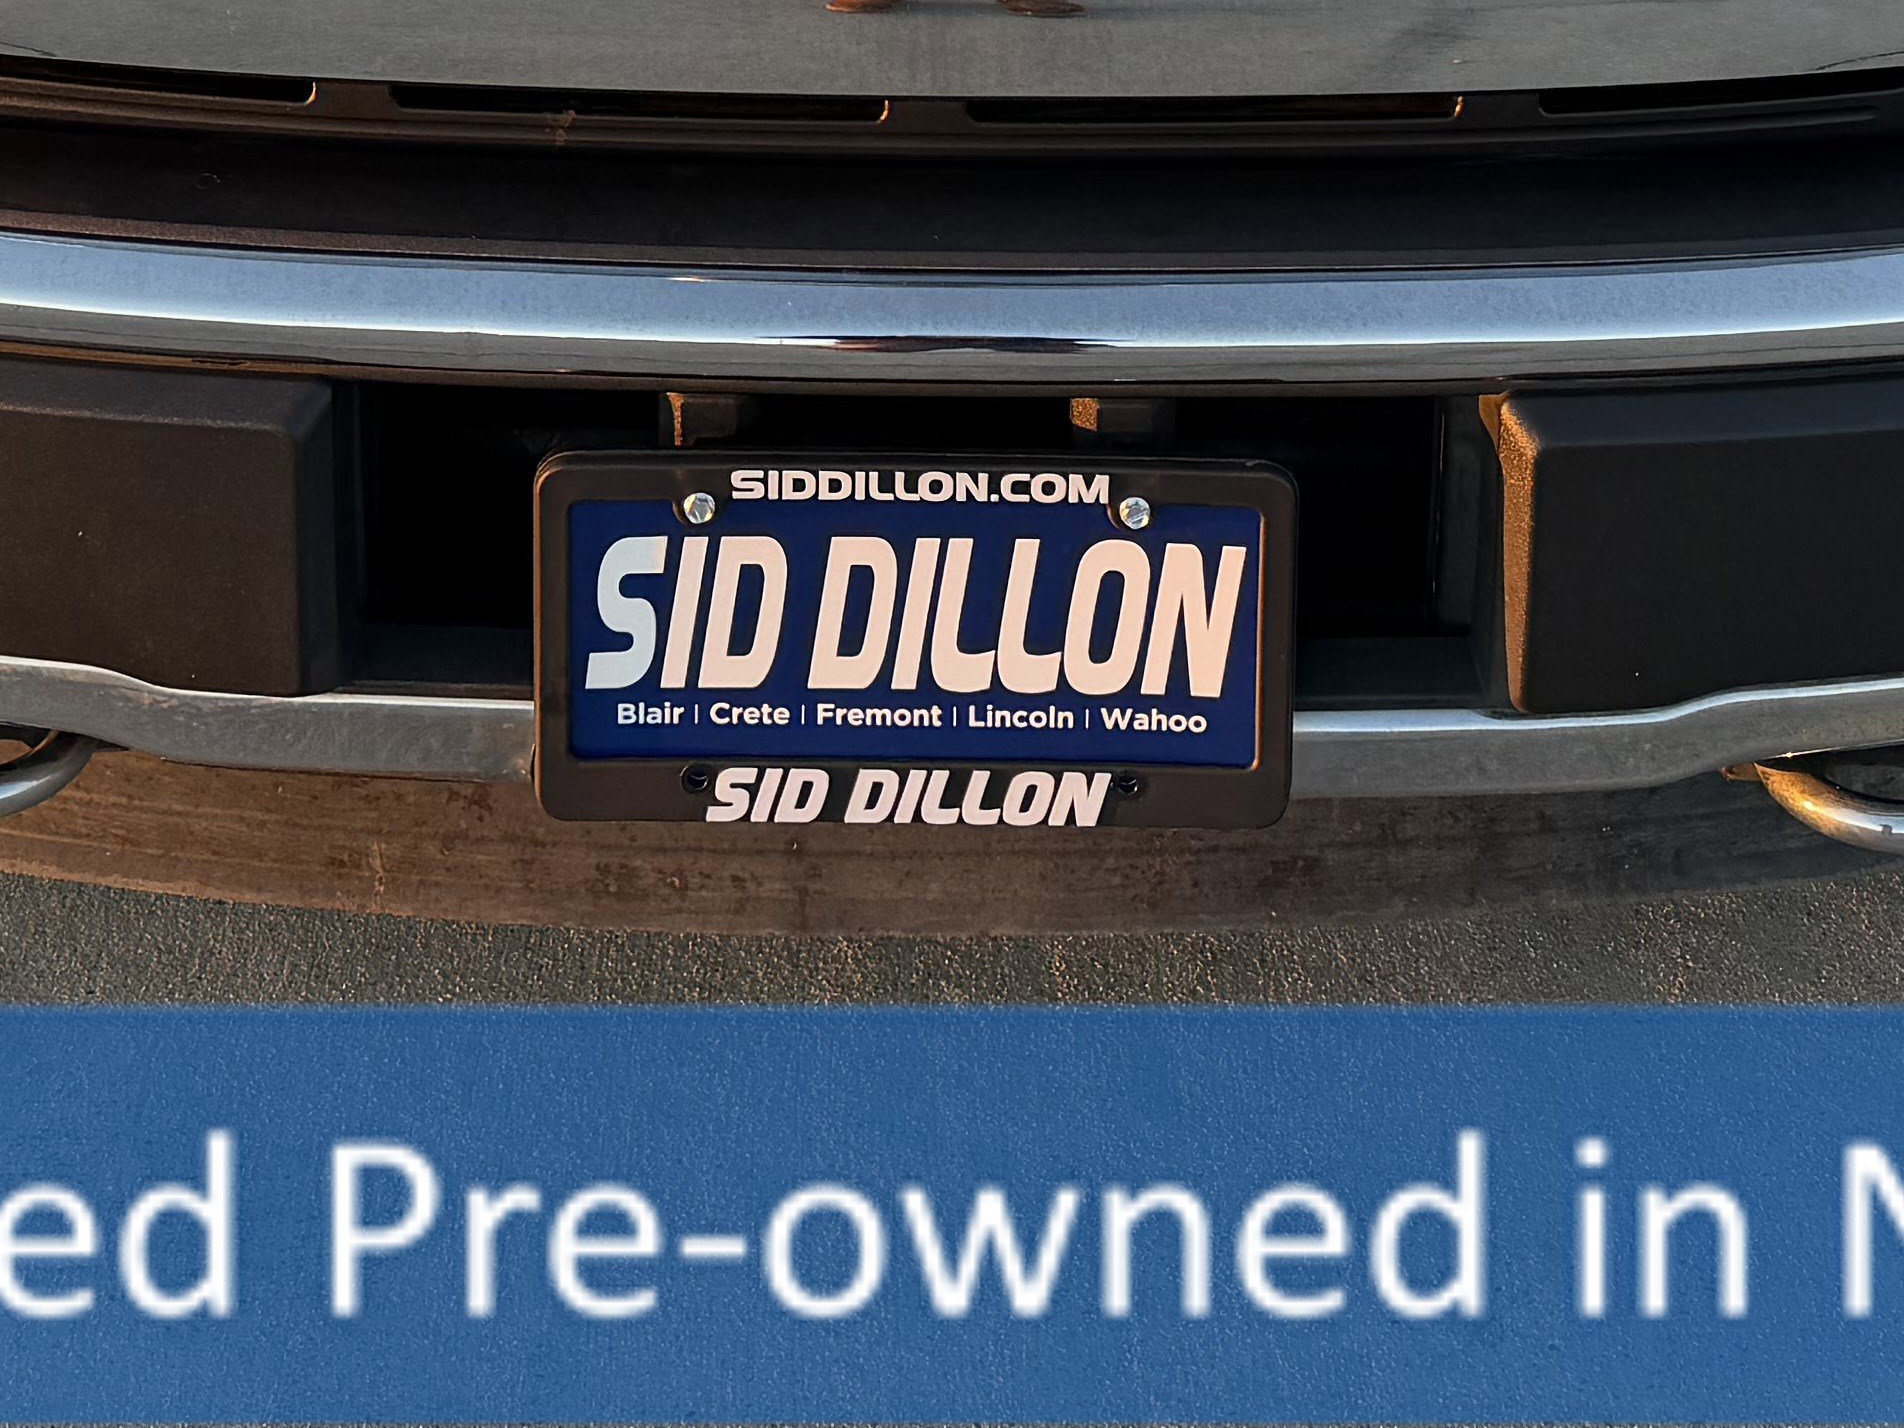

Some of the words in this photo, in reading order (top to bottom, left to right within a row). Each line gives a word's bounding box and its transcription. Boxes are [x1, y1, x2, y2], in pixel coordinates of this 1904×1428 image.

[730, 469, 1110, 505] SIDDILLON.COM
[585, 535, 788, 691] SID
[807, 536, 1247, 698] DILLON
[616, 701, 685, 725] Blair
[709, 702, 791, 725] Crete
[815, 702, 943, 727] Fremont
[968, 704, 1074, 729] Lincoln
[1100, 706, 1208, 733] Wahoo
[703, 767, 830, 824] SID
[843, 768, 1114, 827] DILLON
